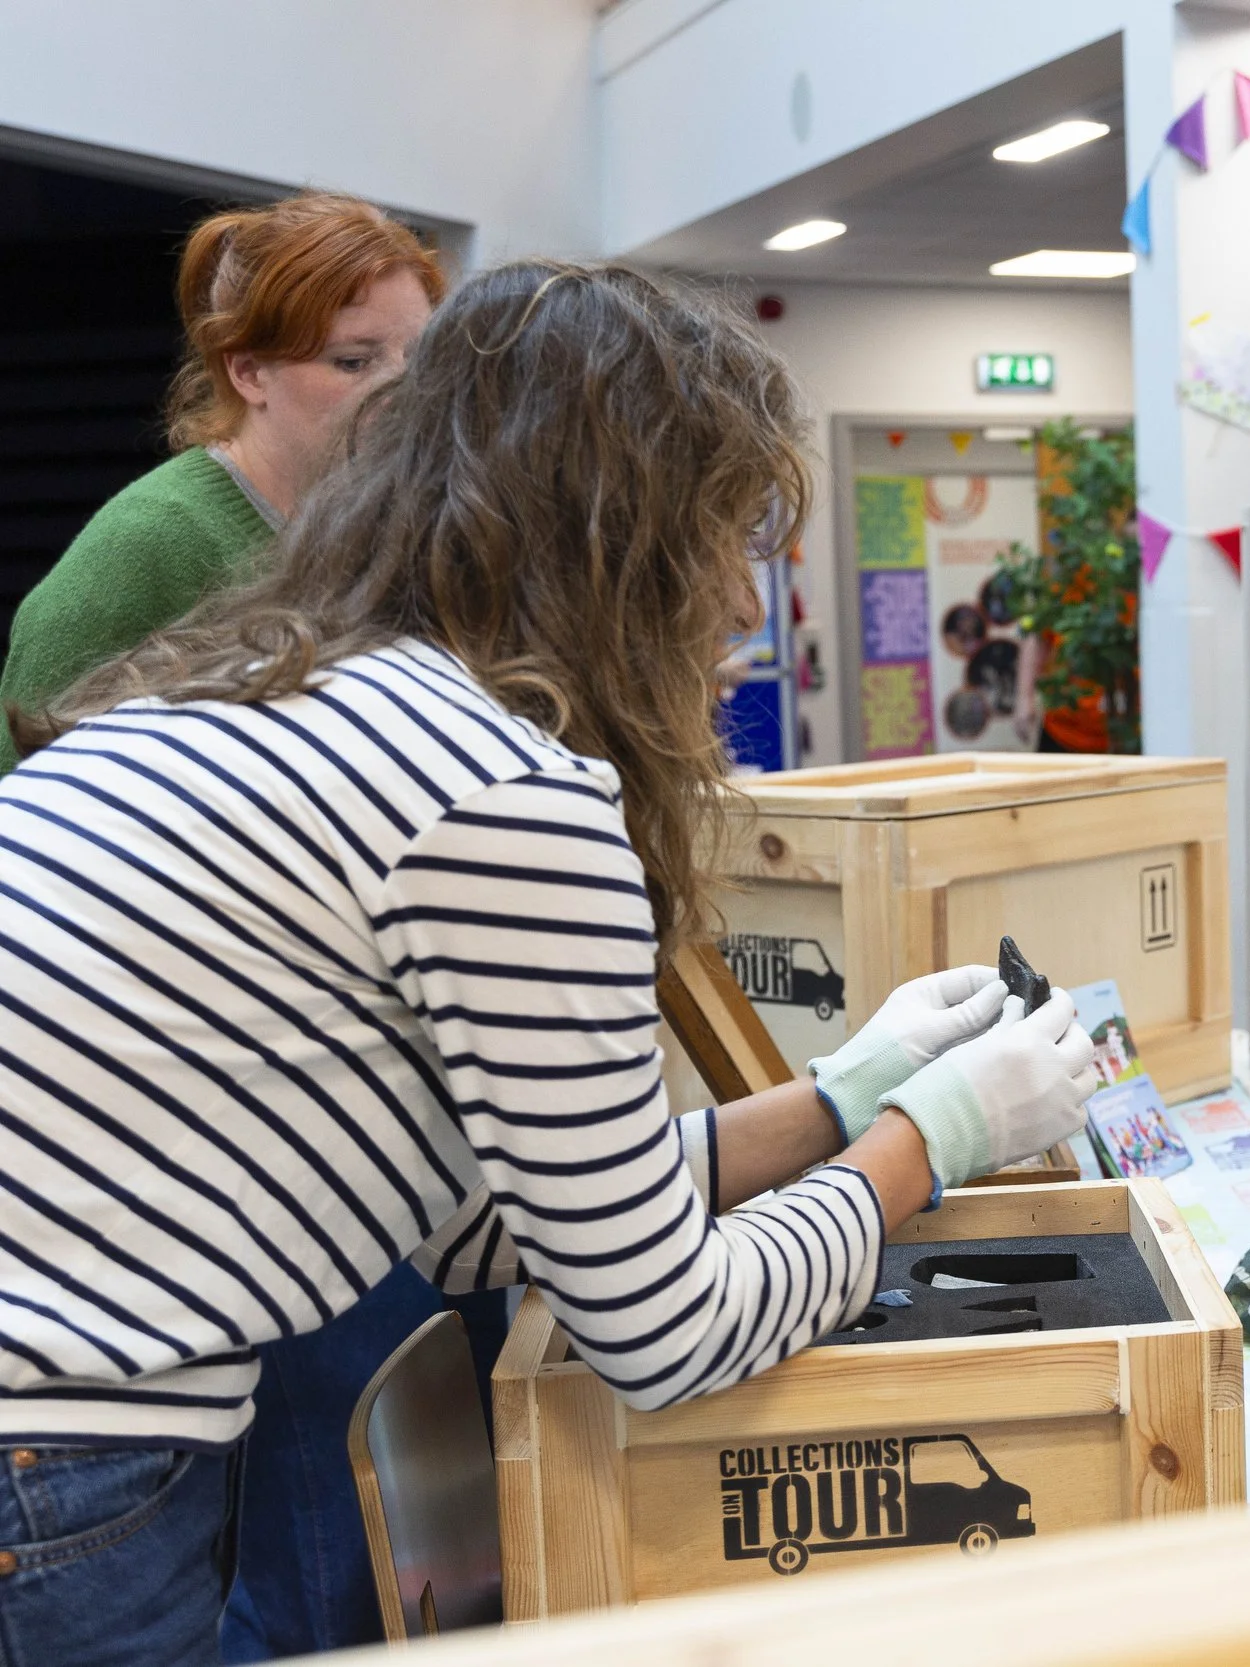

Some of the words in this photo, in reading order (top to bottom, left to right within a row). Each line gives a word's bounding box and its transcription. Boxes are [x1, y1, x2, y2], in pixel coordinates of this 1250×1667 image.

[717, 932, 788, 954] OLLECTIONS
[719, 1438, 900, 1477] COLLECTIONS
[721, 1468, 904, 1546] TOUR
[722, 1494, 741, 1515] ON
